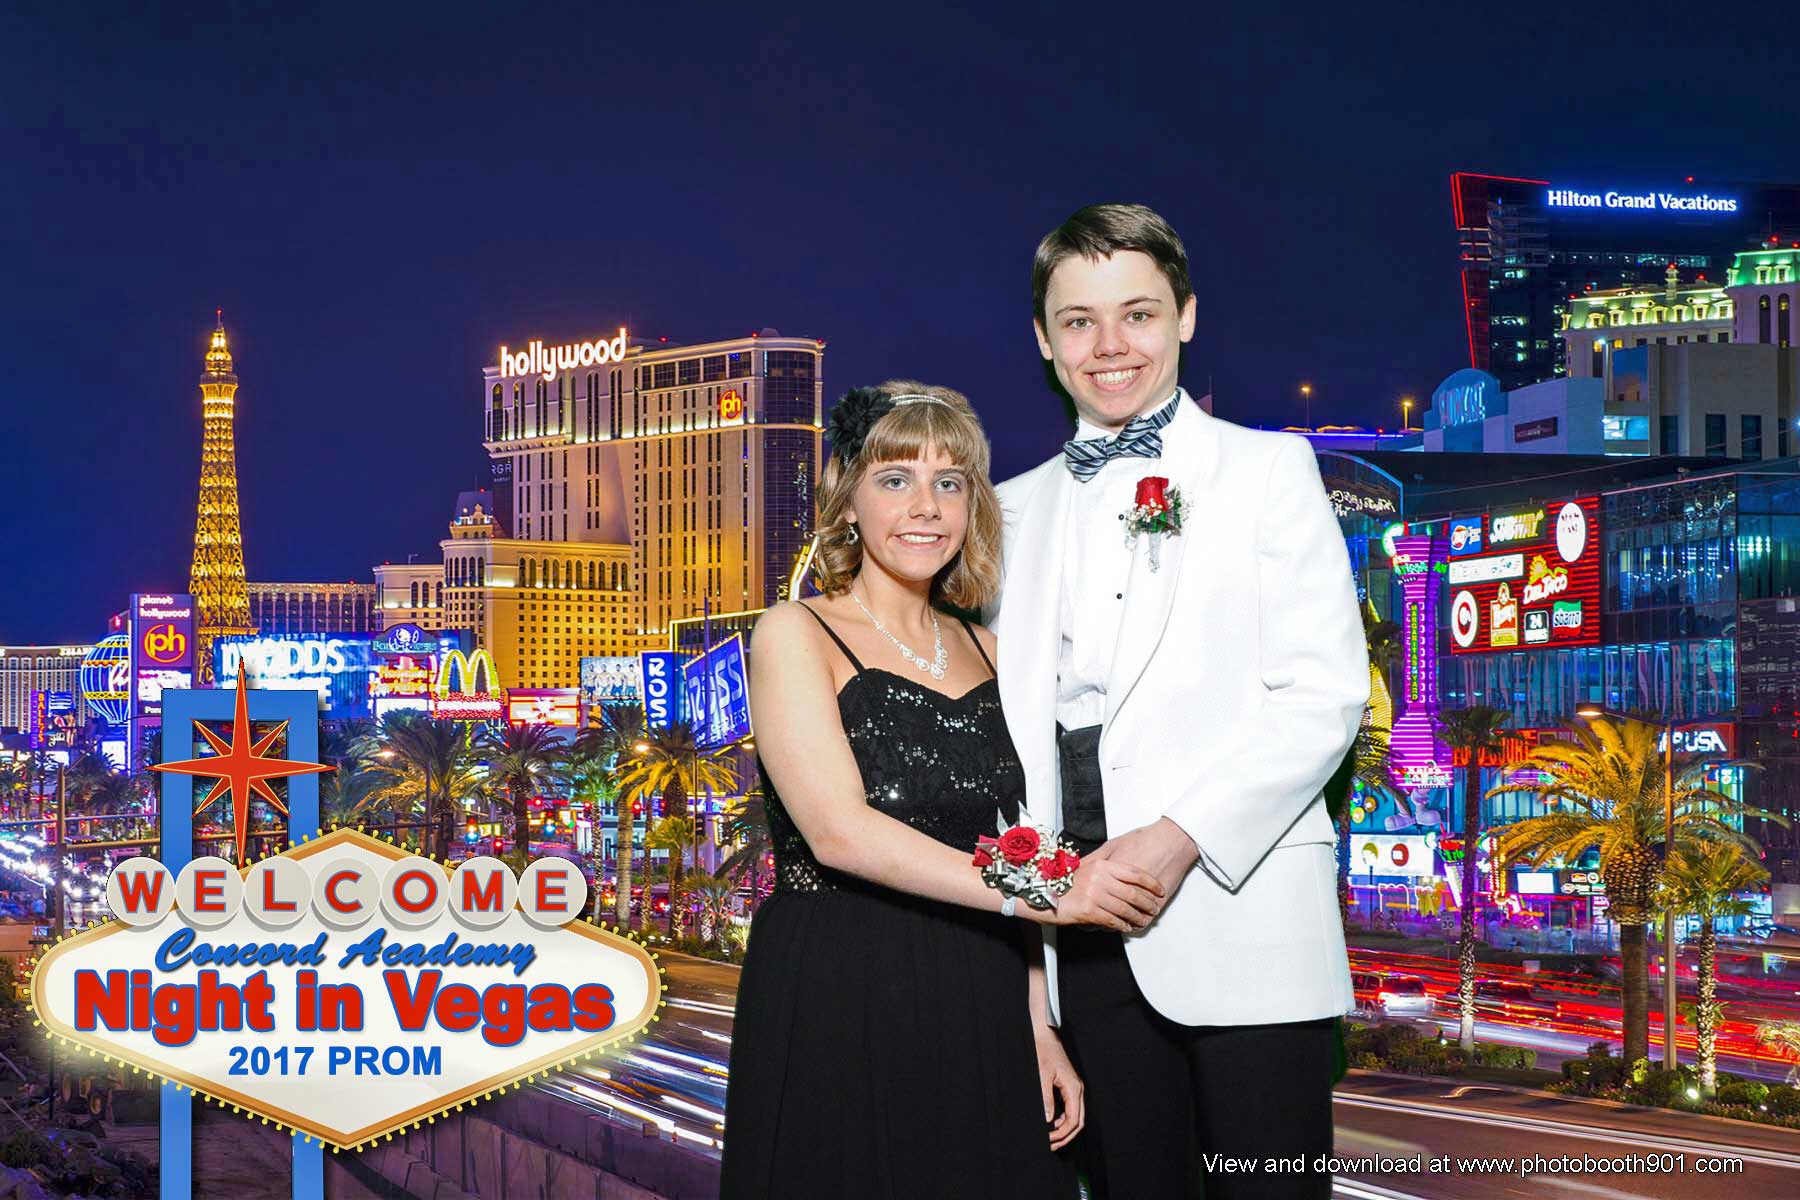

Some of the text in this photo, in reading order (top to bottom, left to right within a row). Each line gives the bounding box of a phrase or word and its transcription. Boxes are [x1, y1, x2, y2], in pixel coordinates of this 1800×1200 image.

[1547, 190, 1737, 211] Hilton Grand Vacations
[501, 327, 626, 381] hollywood
[1489, 509, 1545, 543] SUBWAY
[140, 594, 174, 607] planet
[140, 607, 190, 620] hollywood
[1554, 607, 1580, 627] sbarro
[149, 624, 185, 658] ph
